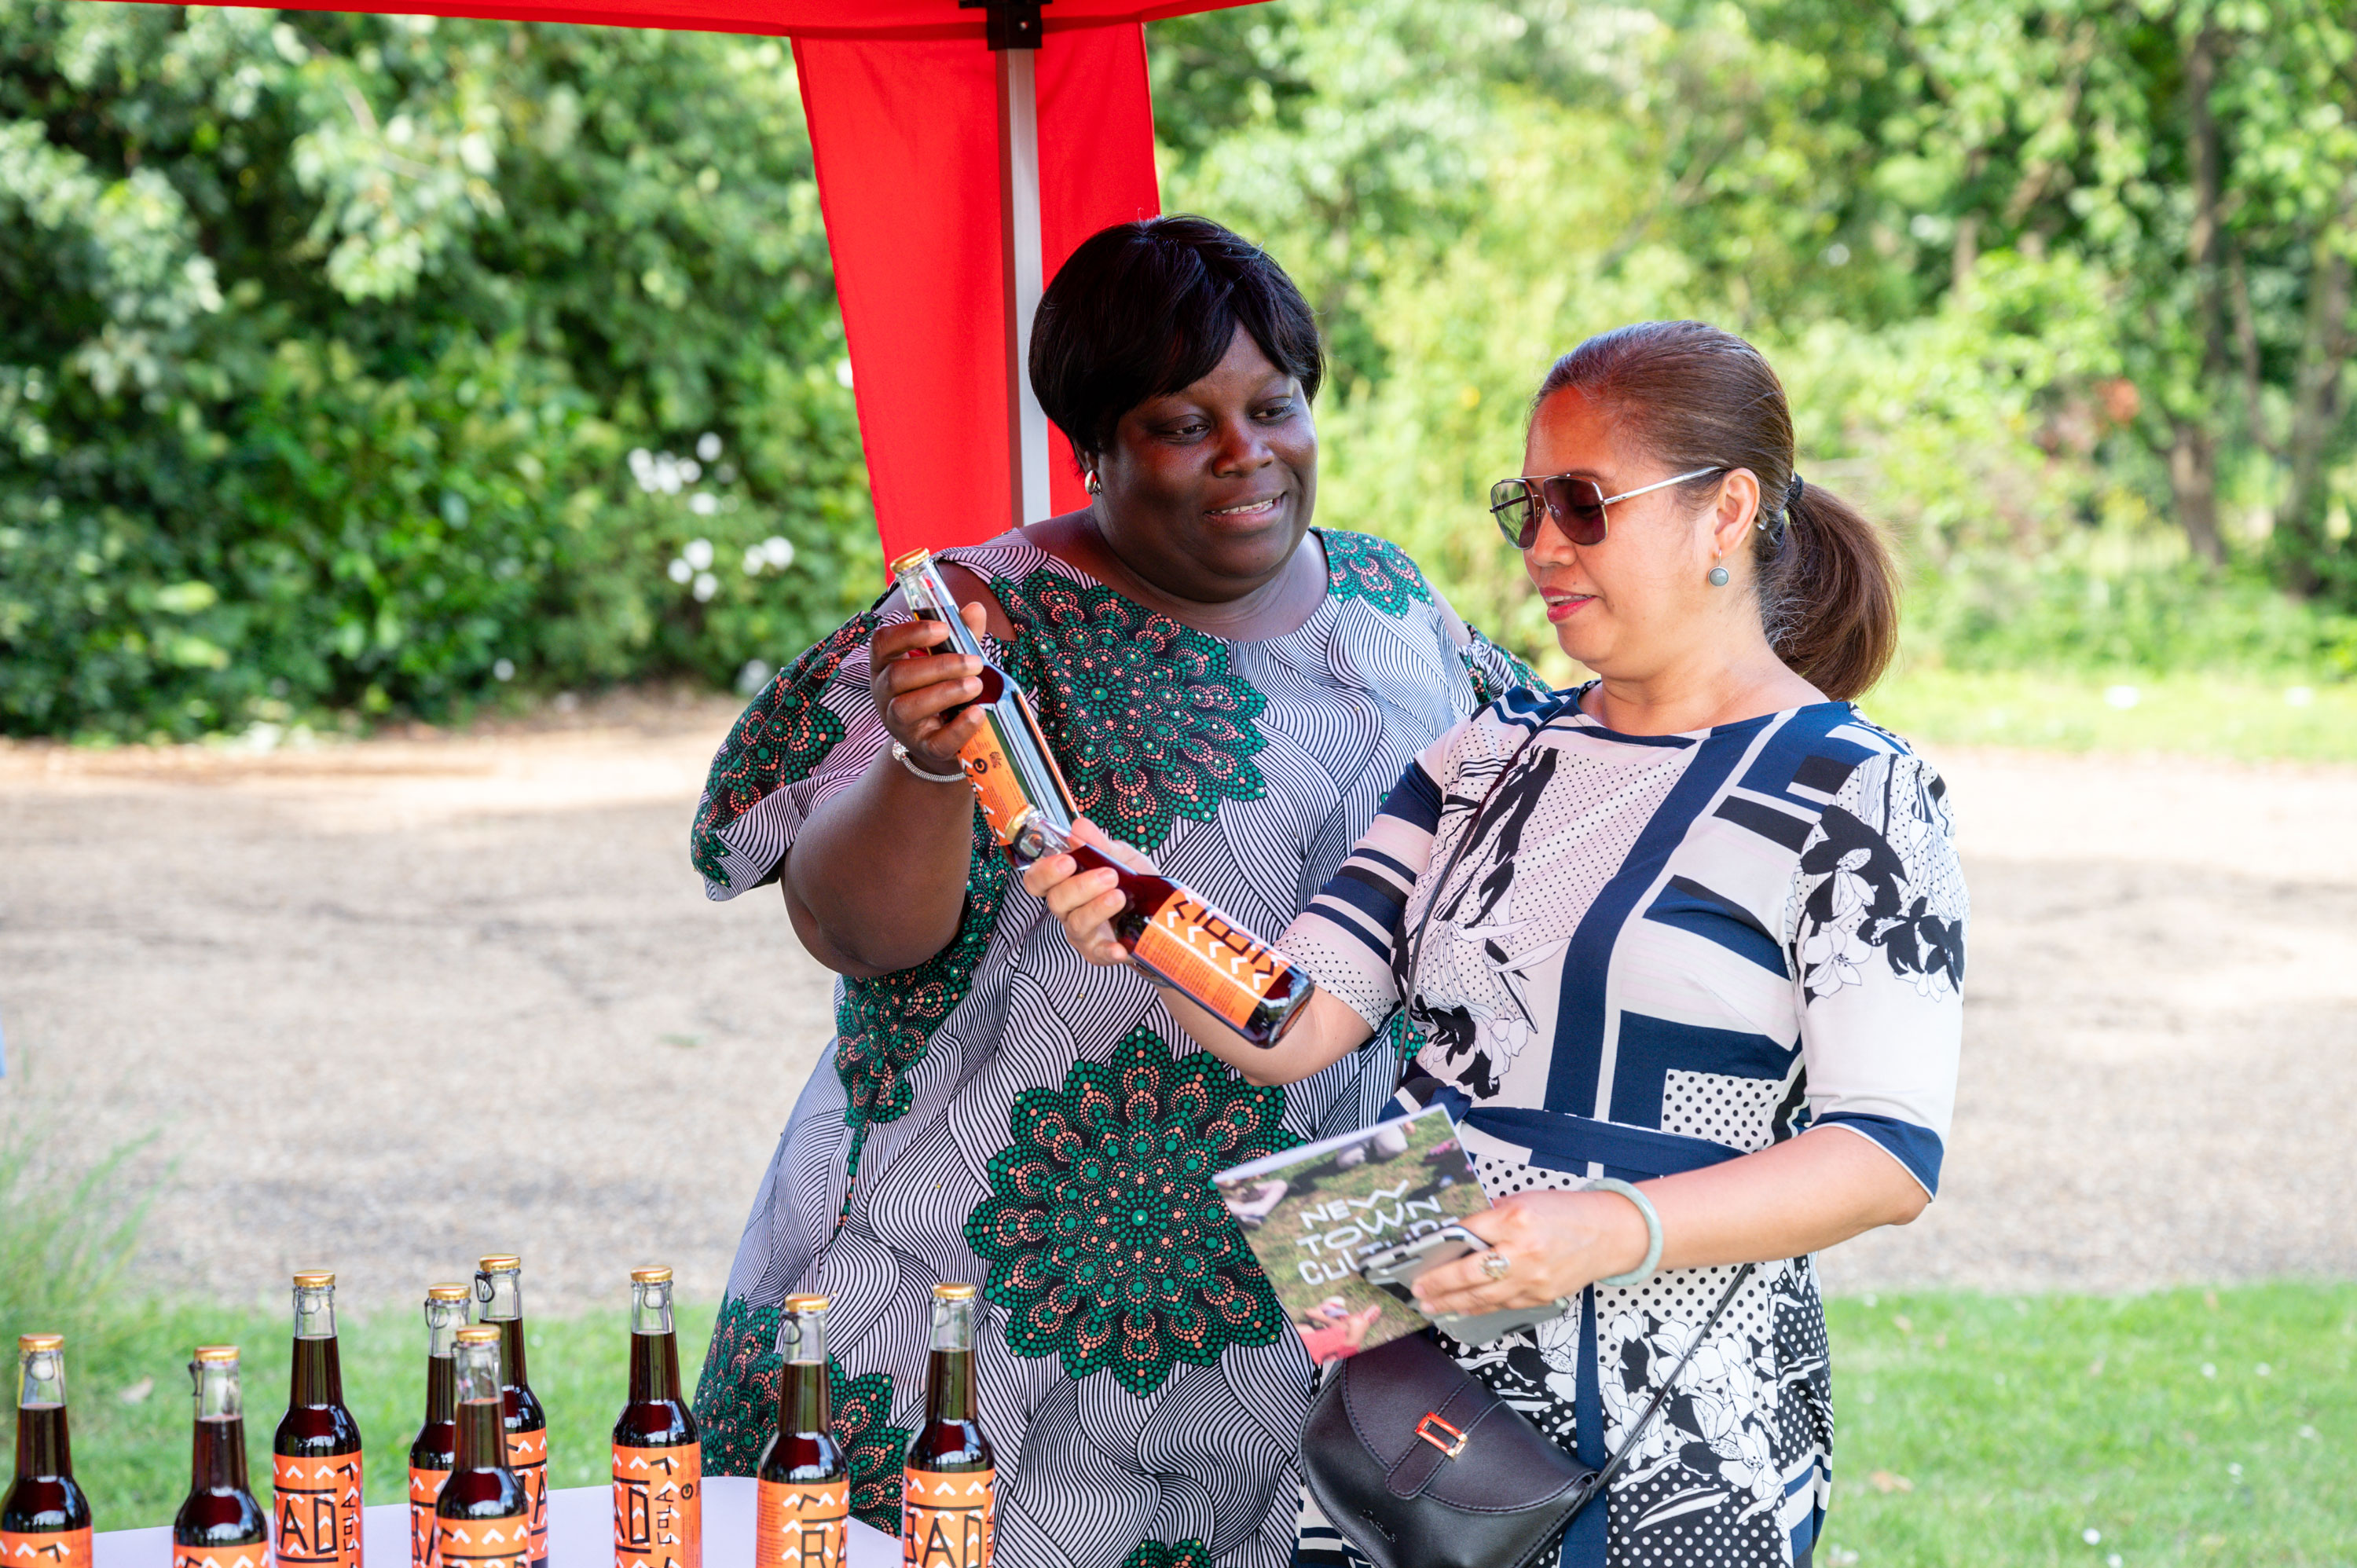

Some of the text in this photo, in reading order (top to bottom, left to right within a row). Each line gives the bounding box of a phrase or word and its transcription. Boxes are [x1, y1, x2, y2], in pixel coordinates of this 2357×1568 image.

[1296, 1195, 1442, 1257] TOWN
[1299, 1179, 1409, 1229] NEW
[341, 1494, 356, 1552] COLA
[654, 1489, 673, 1544] COLA
